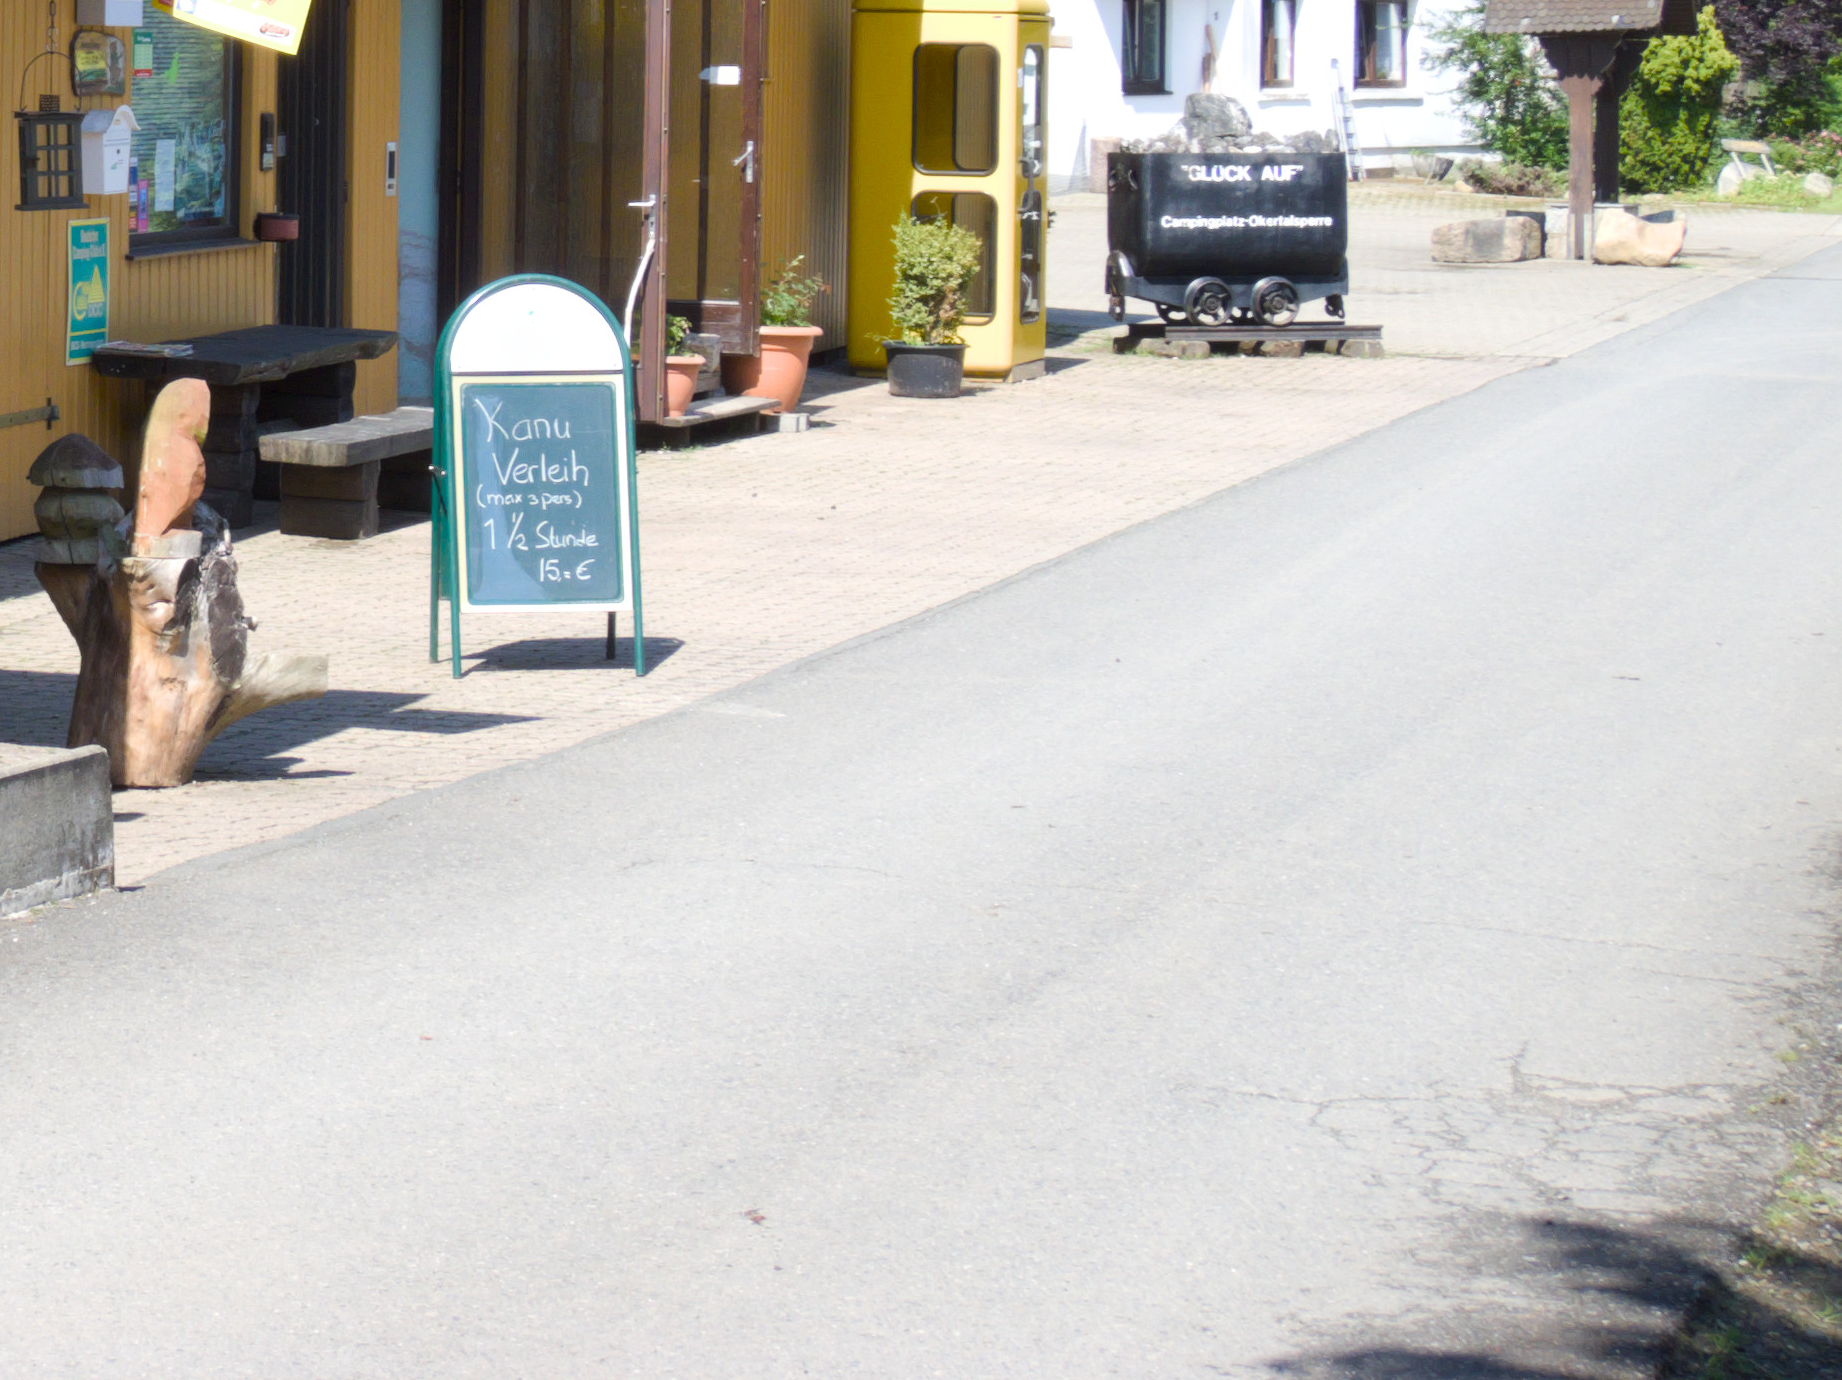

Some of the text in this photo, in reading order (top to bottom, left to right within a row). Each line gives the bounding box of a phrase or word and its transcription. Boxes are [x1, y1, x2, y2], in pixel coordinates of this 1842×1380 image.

[474, 398, 571, 442] Kanu
[492, 448, 589, 486] Verleih
[476, 484, 522, 508] (max
[535, 520, 599, 548] Stunde
